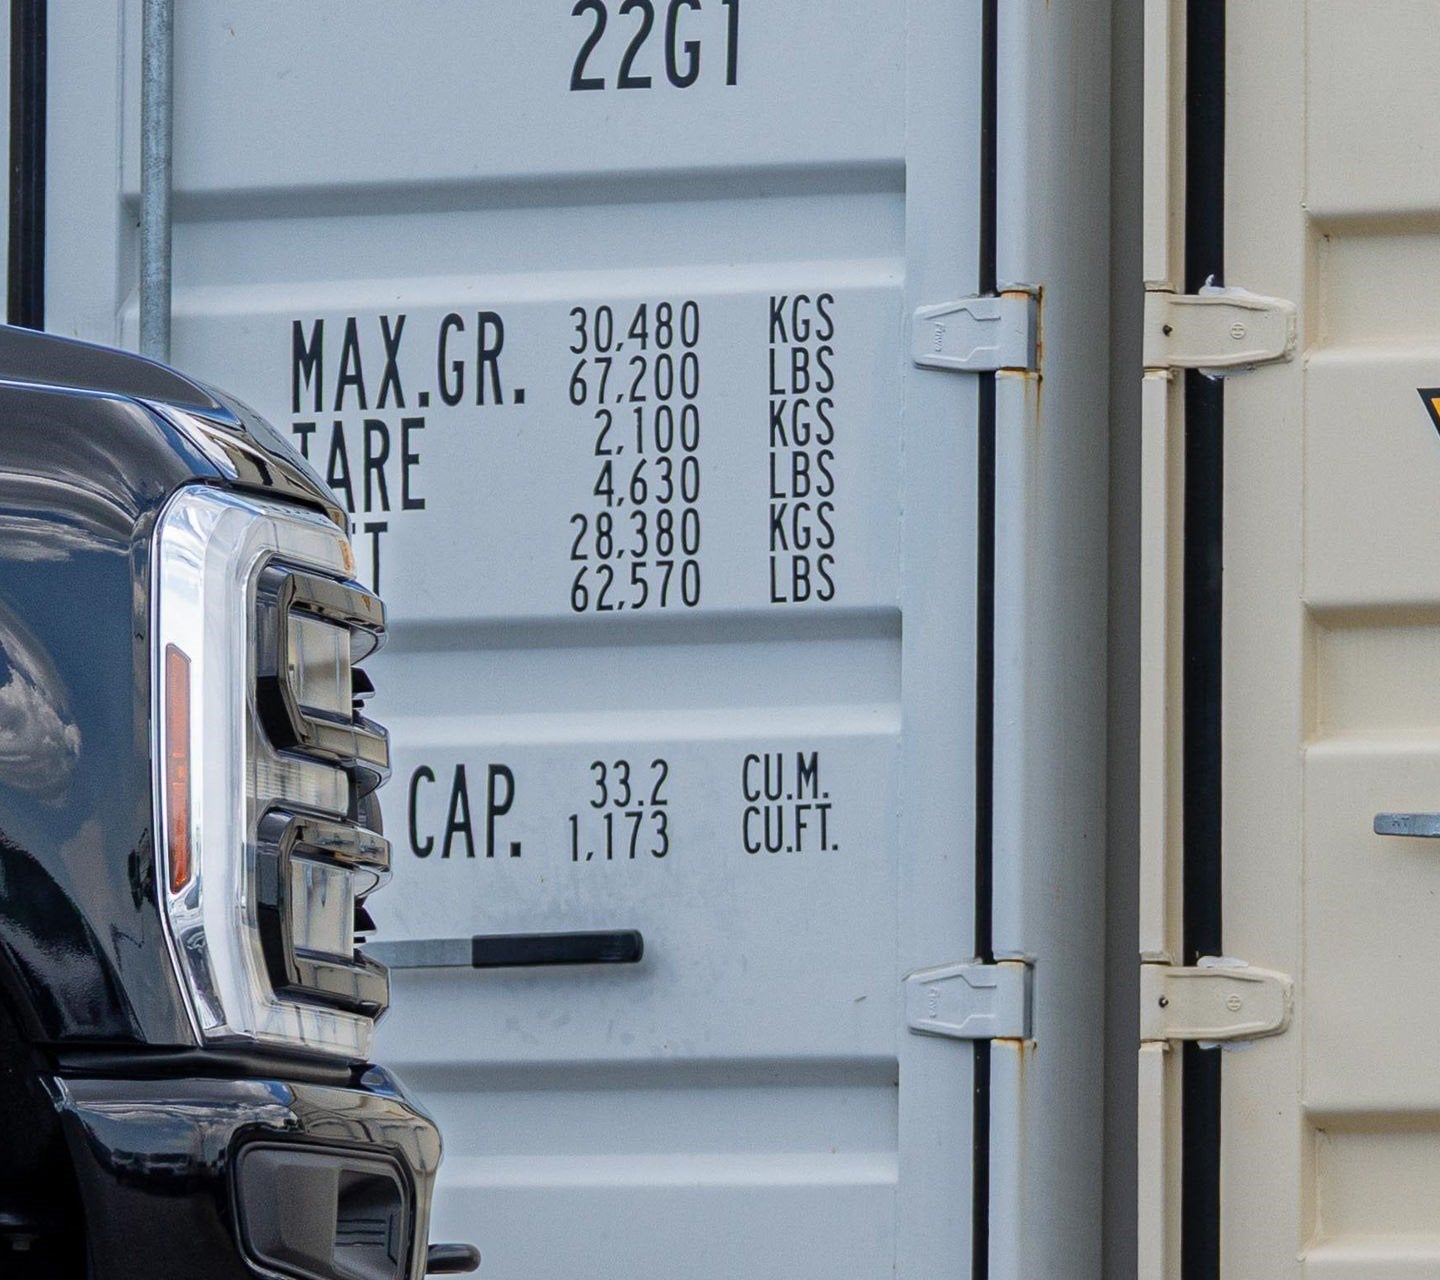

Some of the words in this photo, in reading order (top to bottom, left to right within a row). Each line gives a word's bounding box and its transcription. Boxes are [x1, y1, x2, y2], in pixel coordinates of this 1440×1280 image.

[292, 311, 525, 413] MAX.GR.
[569, 300, 700, 355] 30,480
[769, 293, 835, 344] KGS
[569, 351, 700, 406] 67,200
[769, 345, 835, 395] LBS
[594, 403, 700, 457] 2,100
[769, 397, 835, 448] KGS
[593, 455, 700, 507] 4,630
[769, 449, 835, 499] LBS
[570, 507, 700, 561] 28,380
[769, 501, 835, 552] KGS
[570, 559, 701, 613] 62,570
[769, 553, 835, 603] LBS
[408, 763, 522, 859] CAP.
[590, 759, 669, 810] 33.2
[742, 752, 829, 803] CU.M.
[569, 810, 669, 862] 1,173
[742, 802, 839, 856] CU.FT.
